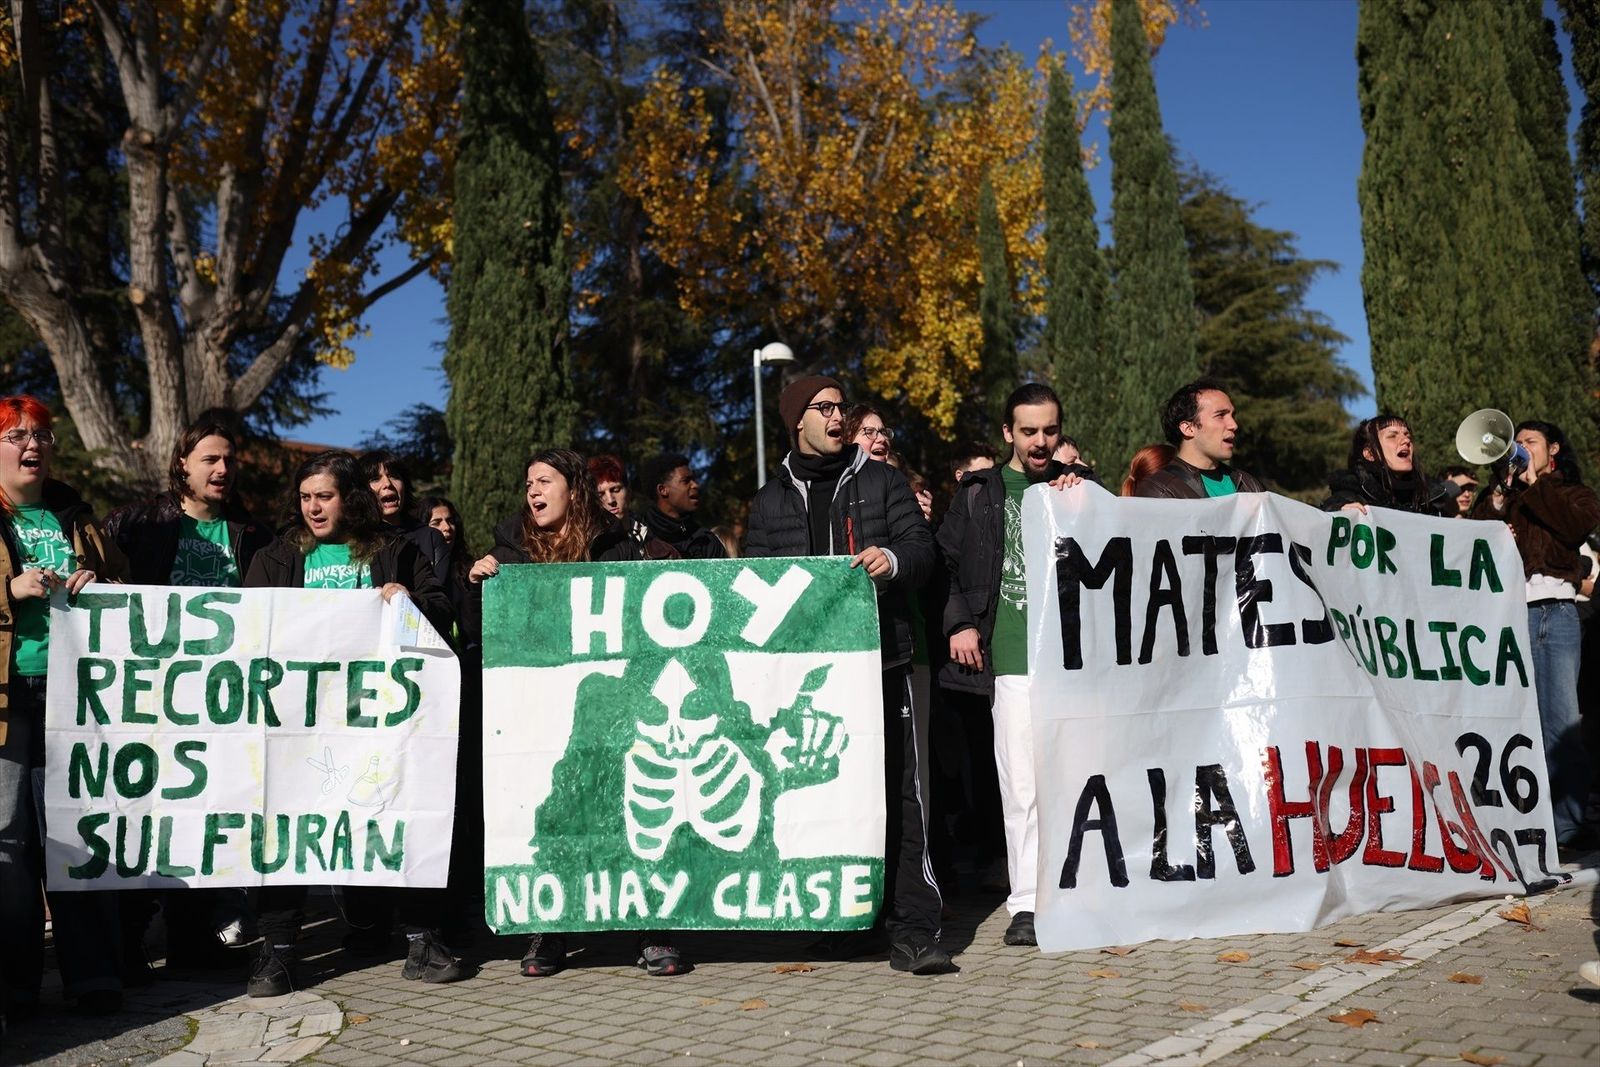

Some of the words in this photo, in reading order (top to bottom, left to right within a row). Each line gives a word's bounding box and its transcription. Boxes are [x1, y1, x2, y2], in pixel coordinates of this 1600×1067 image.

[1326, 516, 1398, 575] POR
[1429, 533, 1504, 593] LA
[72, 591, 242, 659] TUS
[569, 563, 815, 655] HOY
[1055, 532, 1335, 670] MATES
[1329, 604, 1530, 688] PÚBLICA
[76, 657, 424, 729] RECORTES
[68, 740, 208, 801] NOS
[1454, 731, 1539, 815] 26
[67, 809, 406, 880] SULFURAN
[1058, 774, 1130, 890] A
[1147, 763, 1256, 882] LA
[1264, 740, 1517, 884] HUELGA
[495, 871, 565, 924] NO
[585, 869, 690, 922] HAY
[712, 864, 873, 920] CLASE
